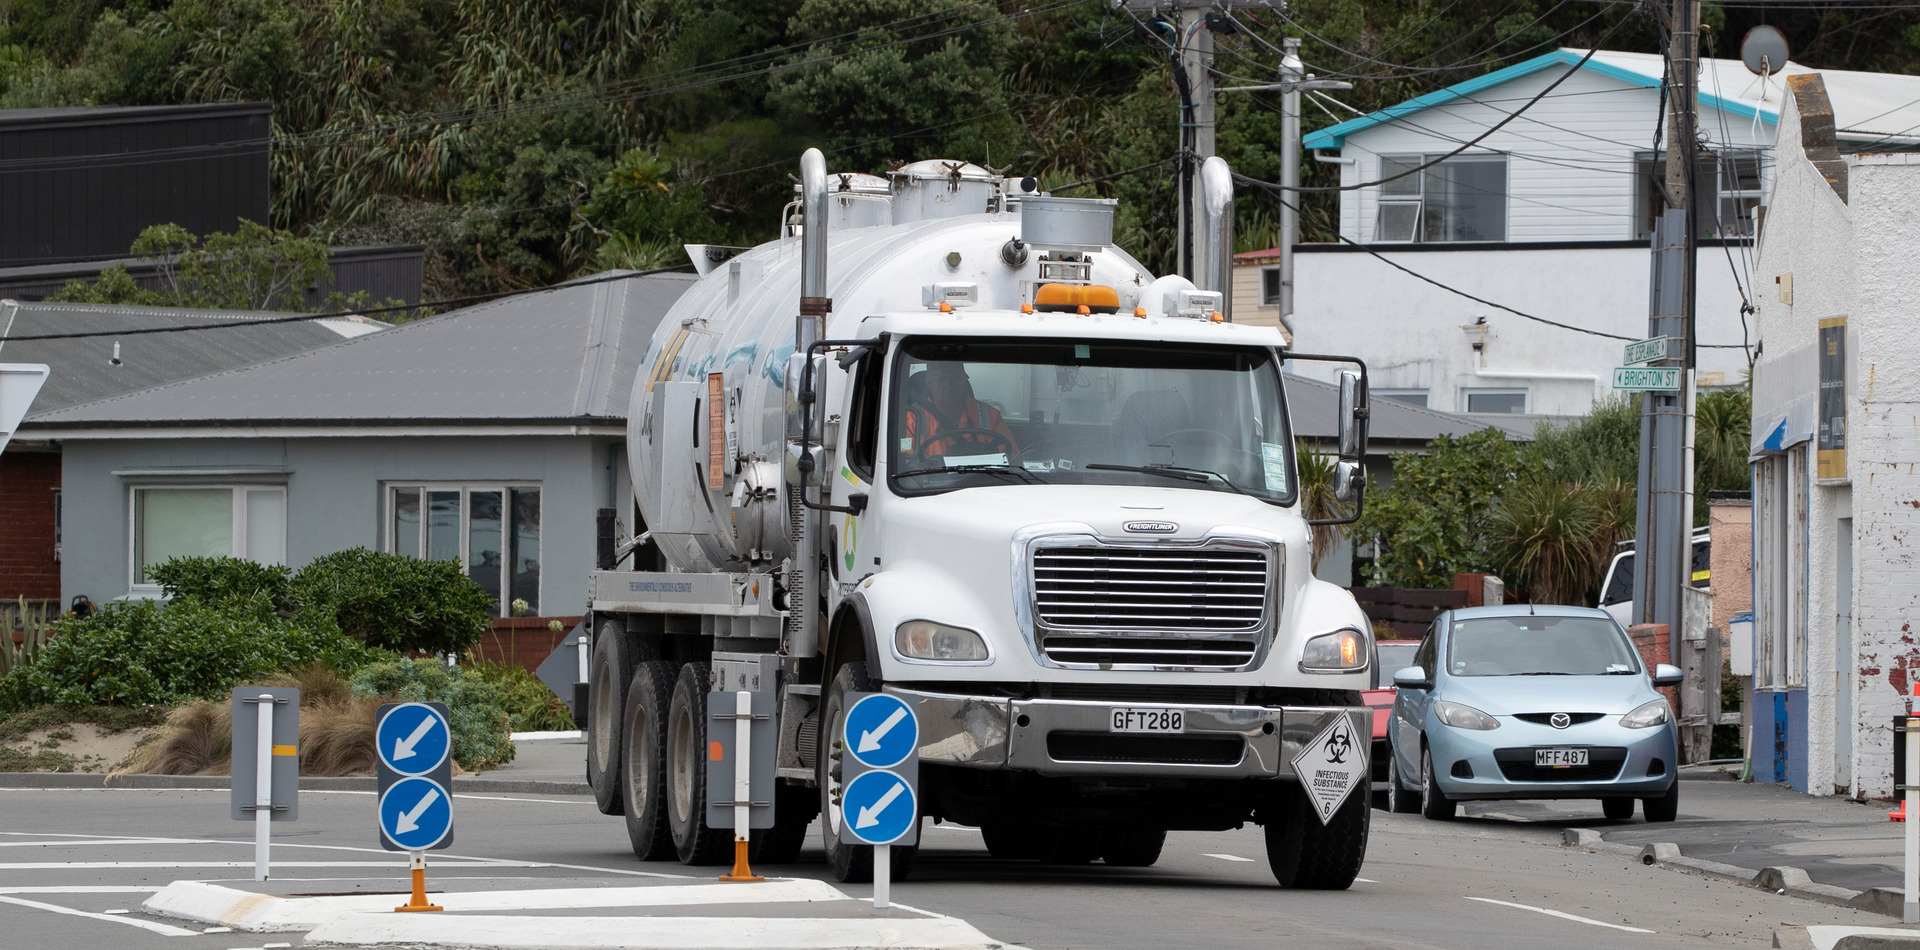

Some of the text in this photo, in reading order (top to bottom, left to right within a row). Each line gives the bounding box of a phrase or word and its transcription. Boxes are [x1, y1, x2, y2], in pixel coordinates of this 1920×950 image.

[1635, 340, 1660, 360] ESPLANADE
[1624, 371, 1676, 386] BRIGHTON ST
[1129, 523, 1173, 531] FREIGHTLINER
[1113, 712, 1182, 730] GFT280
[1537, 751, 1586, 764] MFF487
[1316, 770, 1349, 780] INFECTIOUS
[1313, 778, 1348, 789] SUBSTANCE
[1324, 802, 1330, 814] 6
